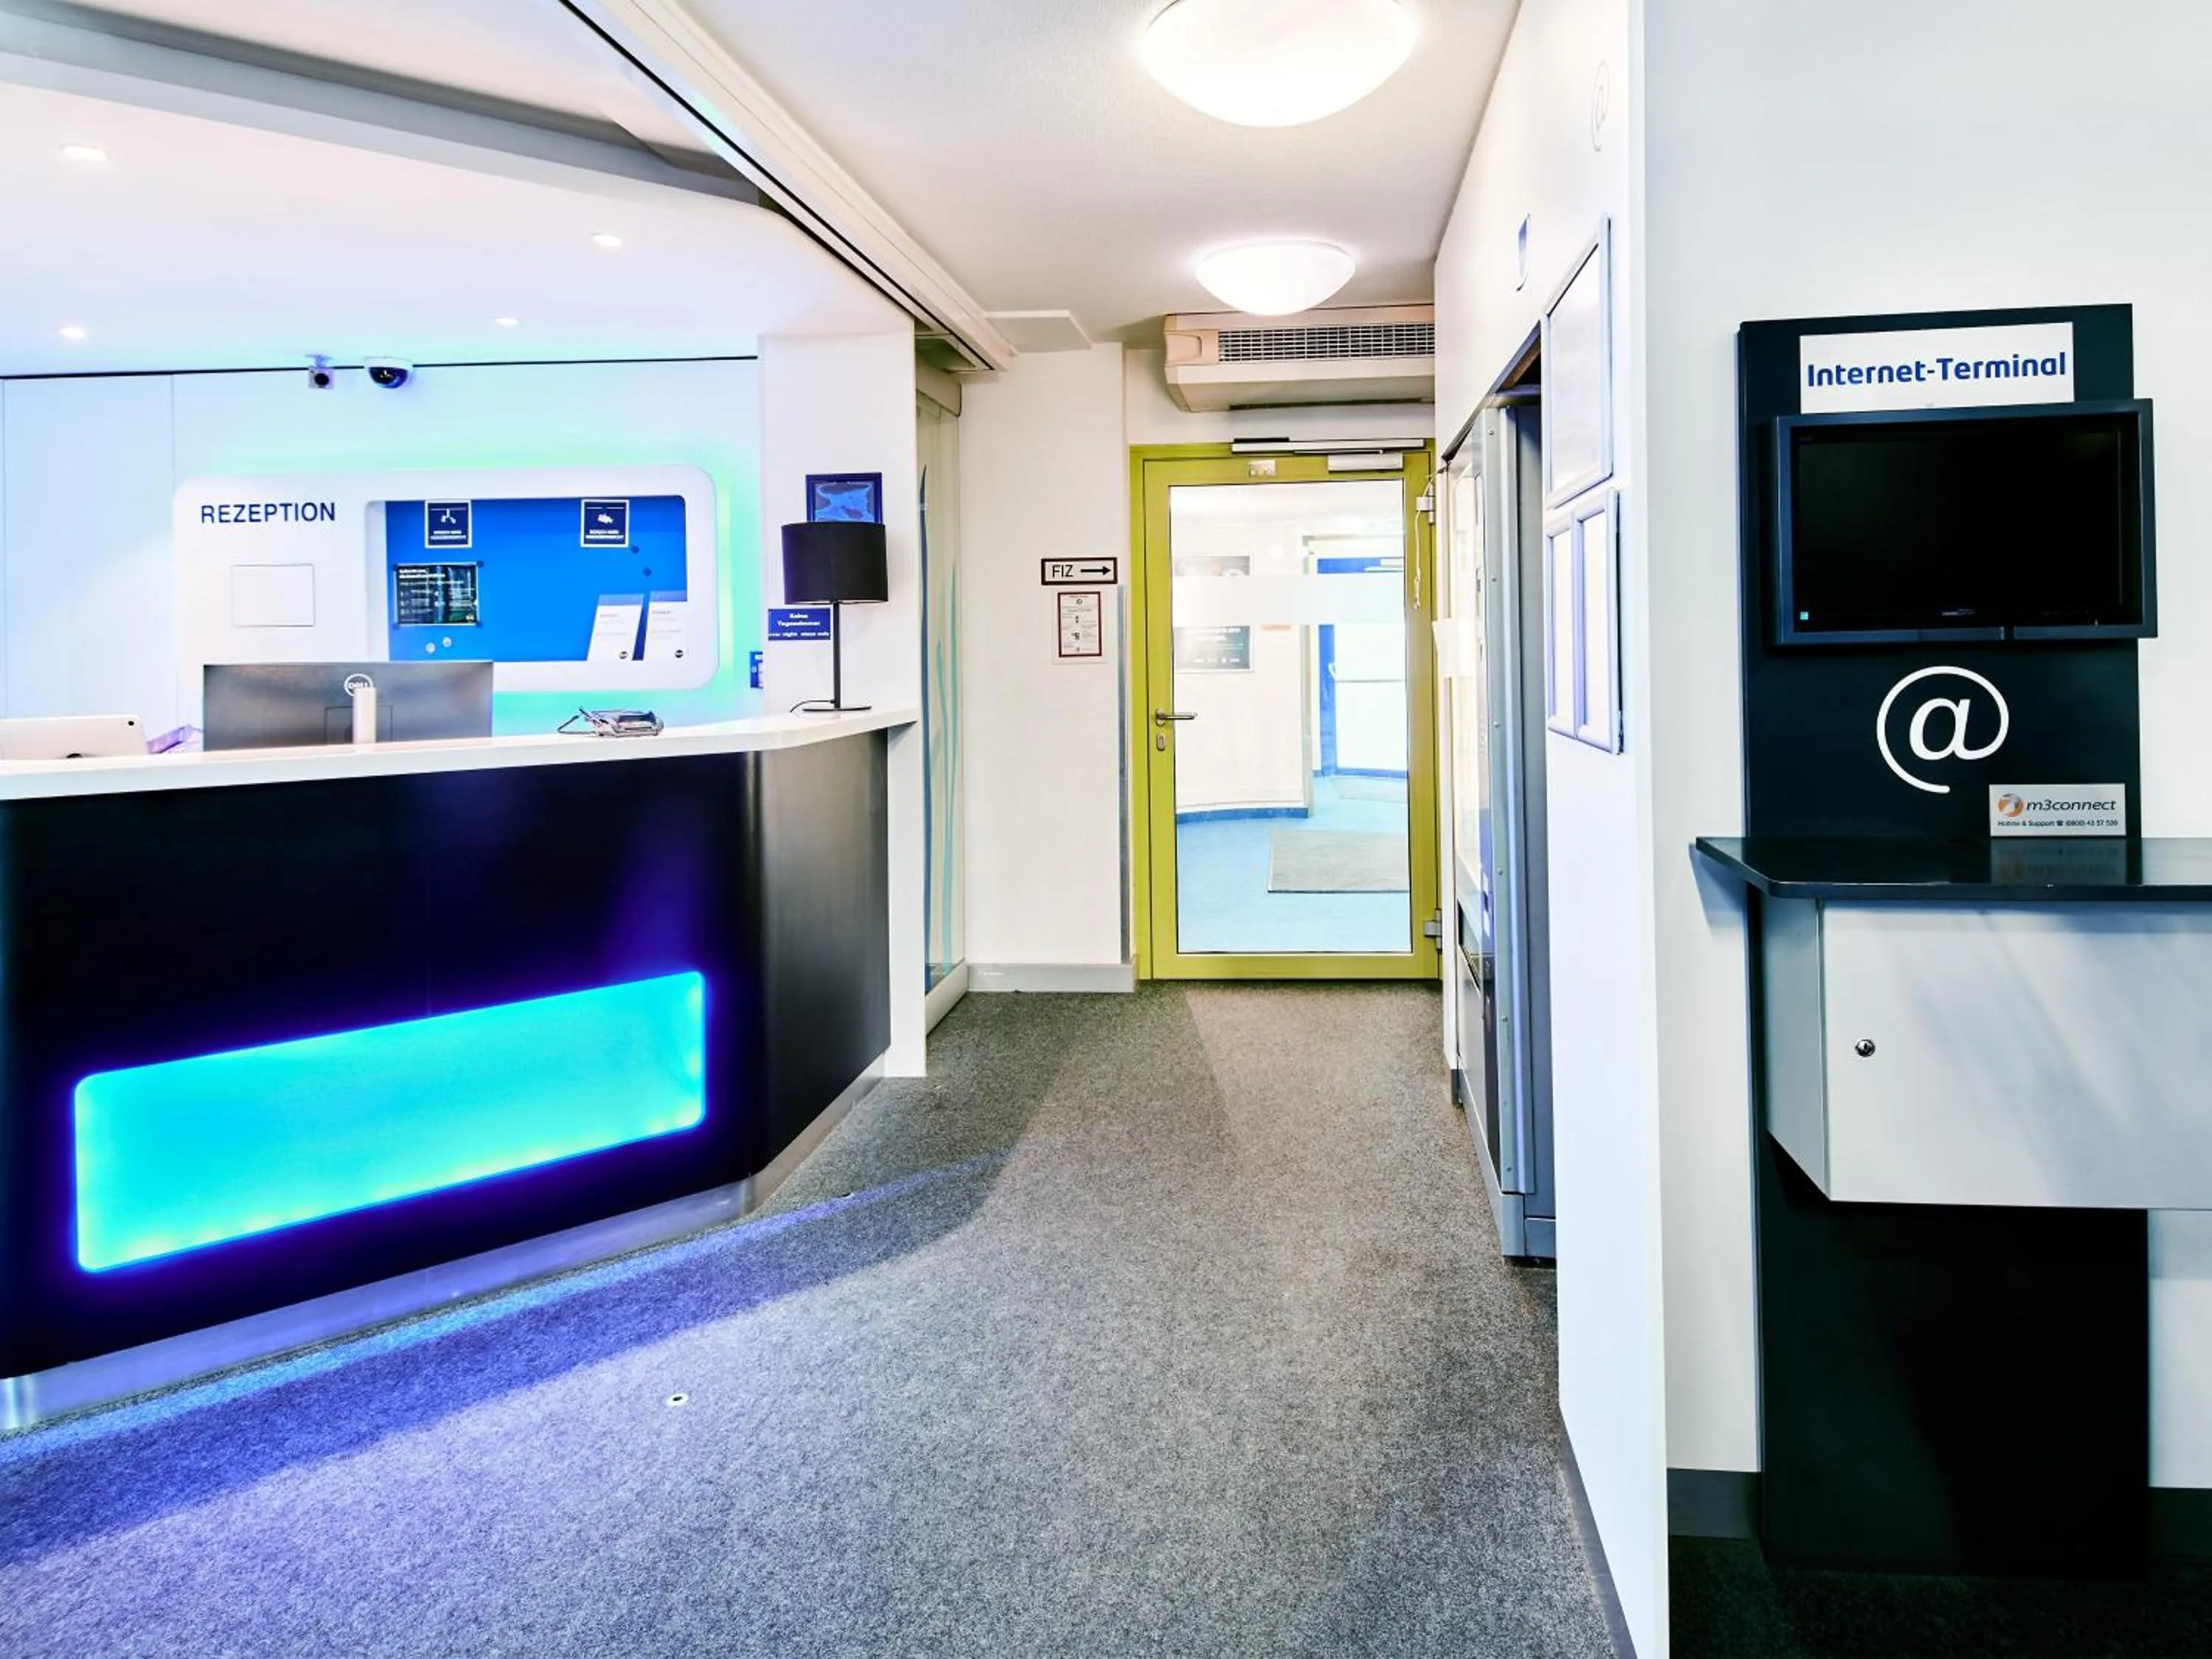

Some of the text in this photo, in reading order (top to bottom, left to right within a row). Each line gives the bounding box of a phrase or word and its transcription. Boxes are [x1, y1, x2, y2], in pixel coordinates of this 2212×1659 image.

[1807, 352, 2065, 387] Internet-Terminal
[201, 502, 335, 524] REZEPTION
[1051, 563, 1074, 578] FIZ
[1877, 666, 2009, 793] @
[2026, 799, 2116, 811] m3connect
